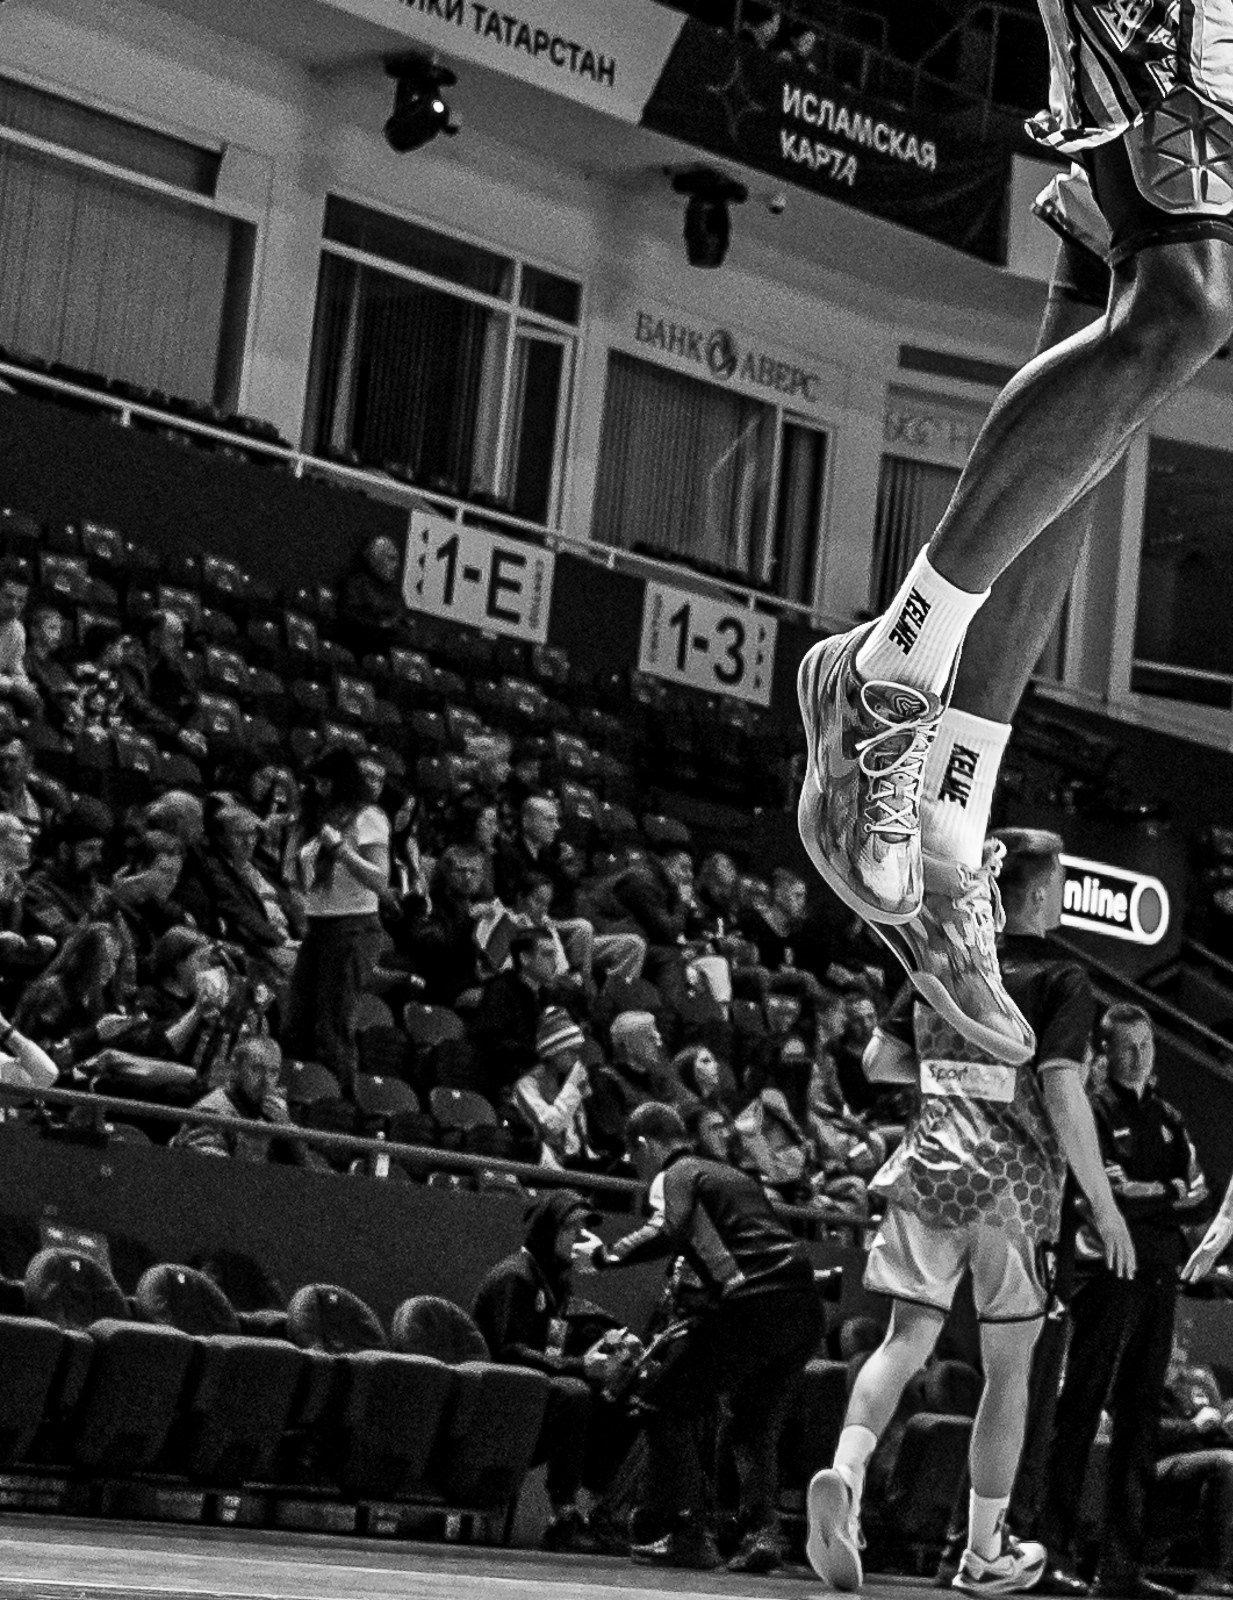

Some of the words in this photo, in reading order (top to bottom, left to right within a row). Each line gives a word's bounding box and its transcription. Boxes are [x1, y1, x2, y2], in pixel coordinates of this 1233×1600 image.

[470, 2, 616, 88] ТАТАРСТАН
[779, 128, 859, 187] КАРТА
[781, 82, 937, 173] ИСЛАМСКАЯ
[634, 309, 705, 361] БАНК
[740, 351, 821, 402] АВЕРС
